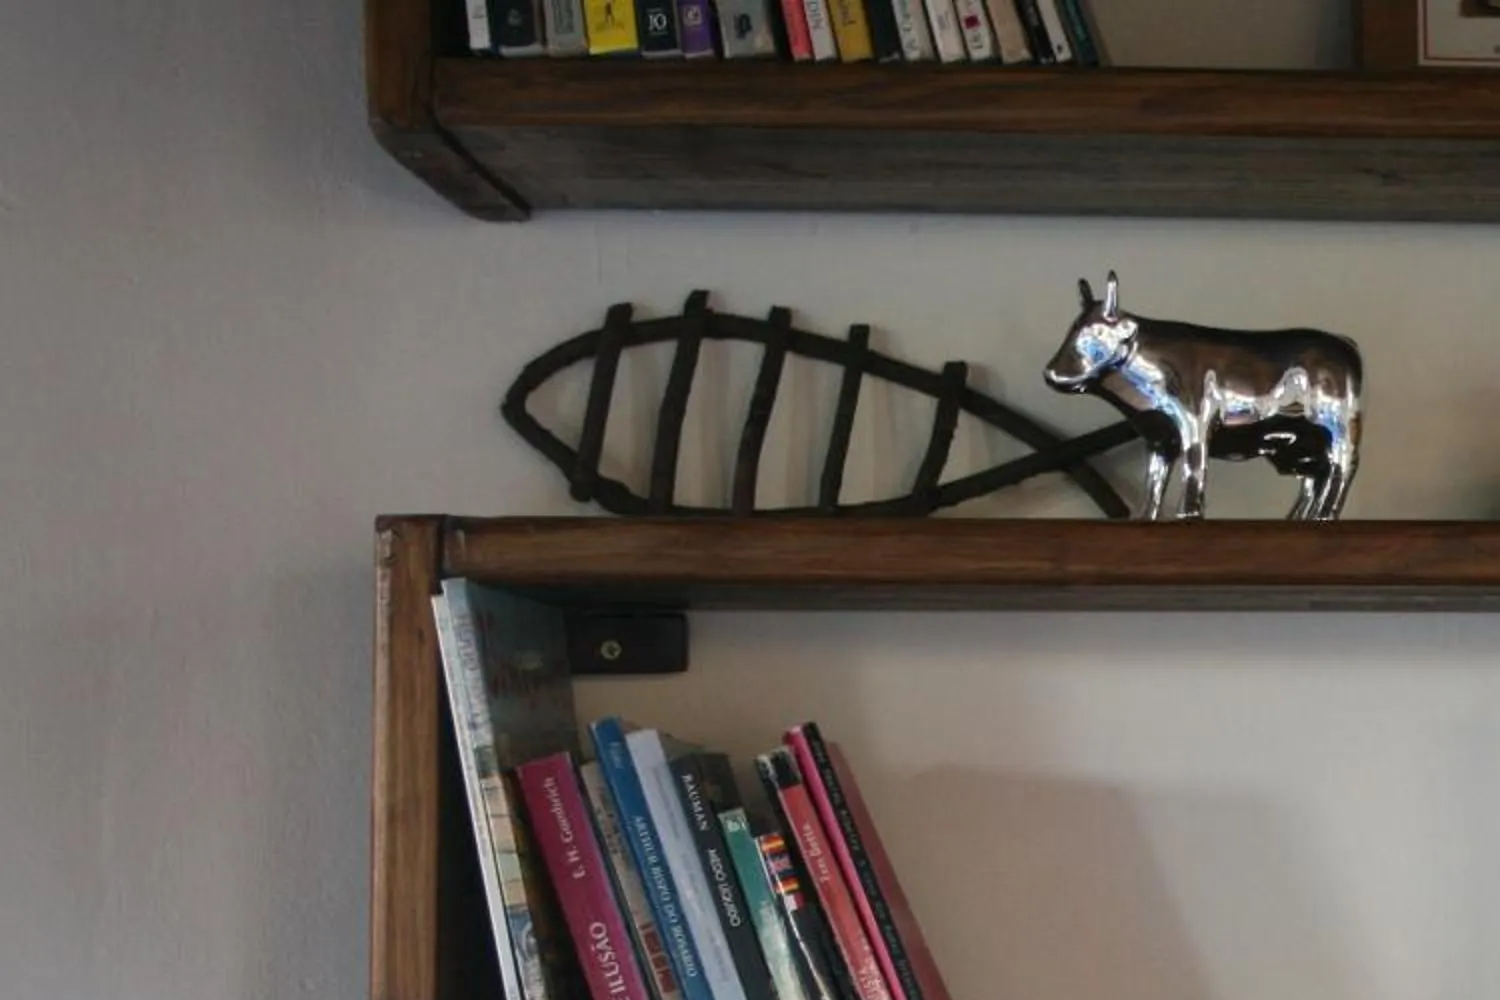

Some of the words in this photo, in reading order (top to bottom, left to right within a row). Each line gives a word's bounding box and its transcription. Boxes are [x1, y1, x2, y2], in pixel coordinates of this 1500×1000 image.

[681, 773, 709, 831] BAUMAN
[707, 848, 727, 882] MEDO
[663, 903, 679, 924] DO
[589, 921, 626, 995] ILUSÃO
